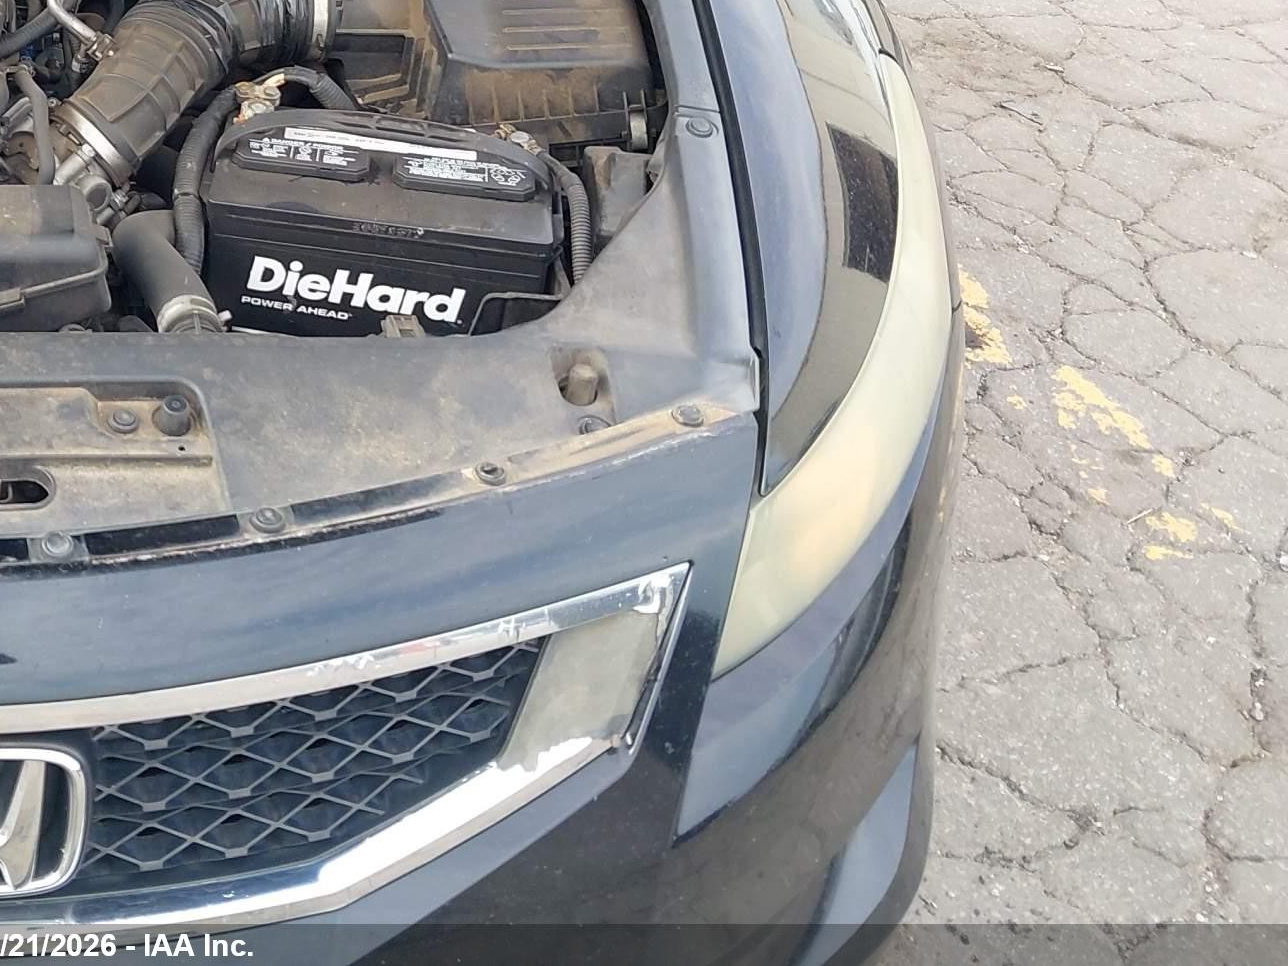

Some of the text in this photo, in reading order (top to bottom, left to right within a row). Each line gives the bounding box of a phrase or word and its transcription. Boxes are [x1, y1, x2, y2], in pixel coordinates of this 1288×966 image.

[241, 295, 349, 320] POWER AHEAD
[246, 255, 466, 323] DieHard
